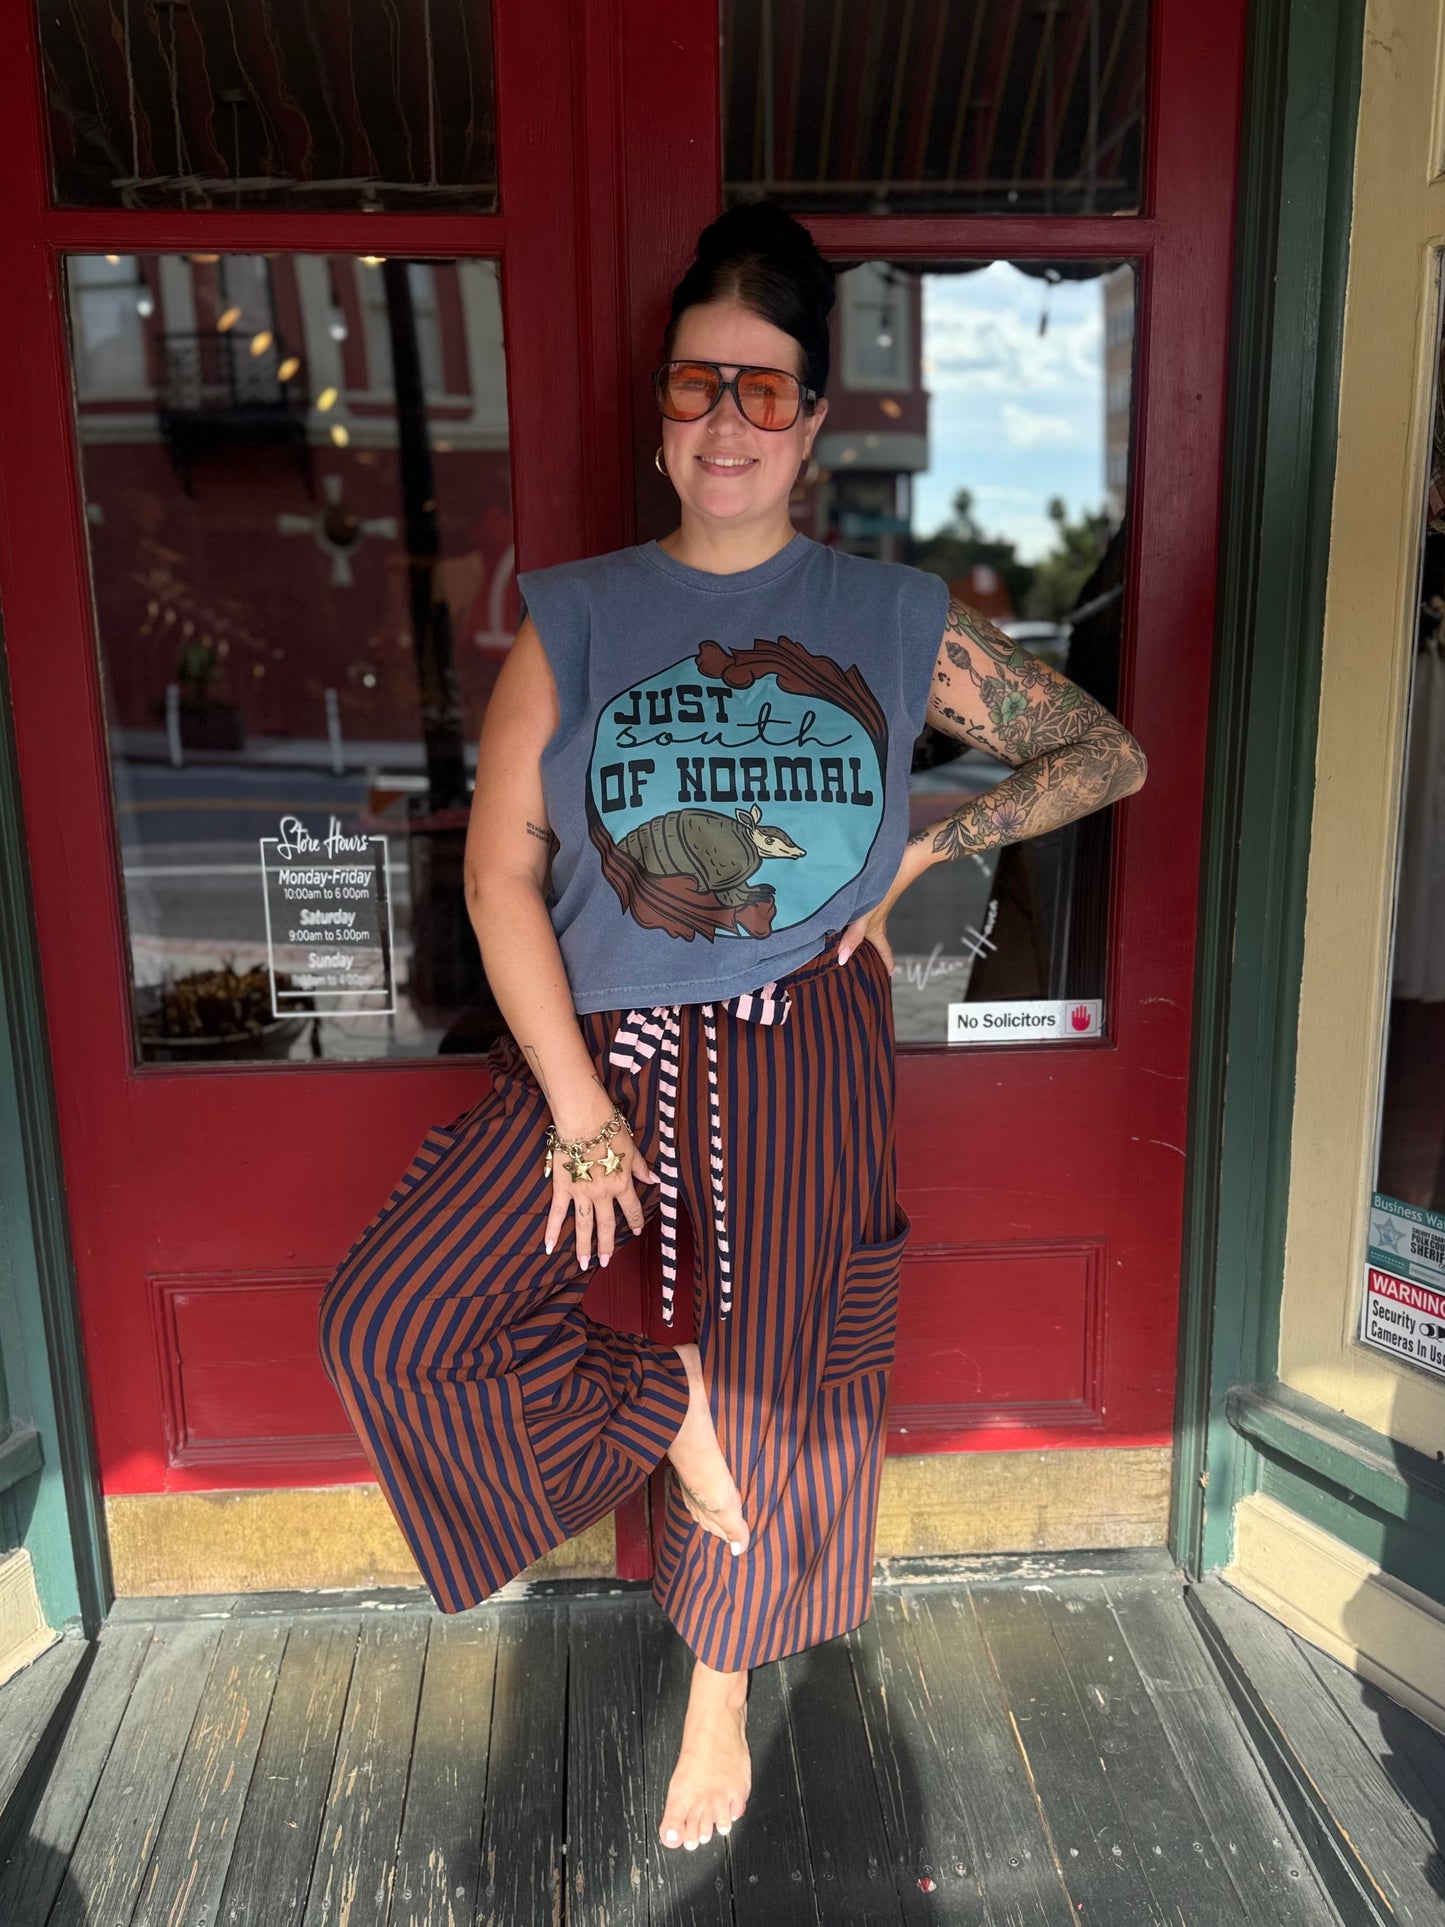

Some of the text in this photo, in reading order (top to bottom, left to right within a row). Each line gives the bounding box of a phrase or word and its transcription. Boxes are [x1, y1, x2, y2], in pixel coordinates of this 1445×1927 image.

[614, 684, 733, 725] JUST
[616, 702, 852, 748] south
[600, 756, 873, 813] OF NORMAL
[277, 816, 369, 860] Store Hours
[279, 868, 371, 887] Monday-Friday
[284, 887, 322, 900] 10:00am
[323, 887, 334, 899] to
[299, 908, 356, 928] Saturday
[289, 930, 323, 943] 9:00am
[324, 930, 335, 942] to
[308, 952, 354, 971] Sunday
[957, 1012, 1056, 1029] No Solicitors
[1374, 1195, 1445, 1230] Business Wa
[1411, 1233, 1430, 1247] POLK
[1372, 1299, 1416, 1334] Security
[1371, 1321, 1414, 1352] Cameras
[1417, 1339, 1427, 1359] In
